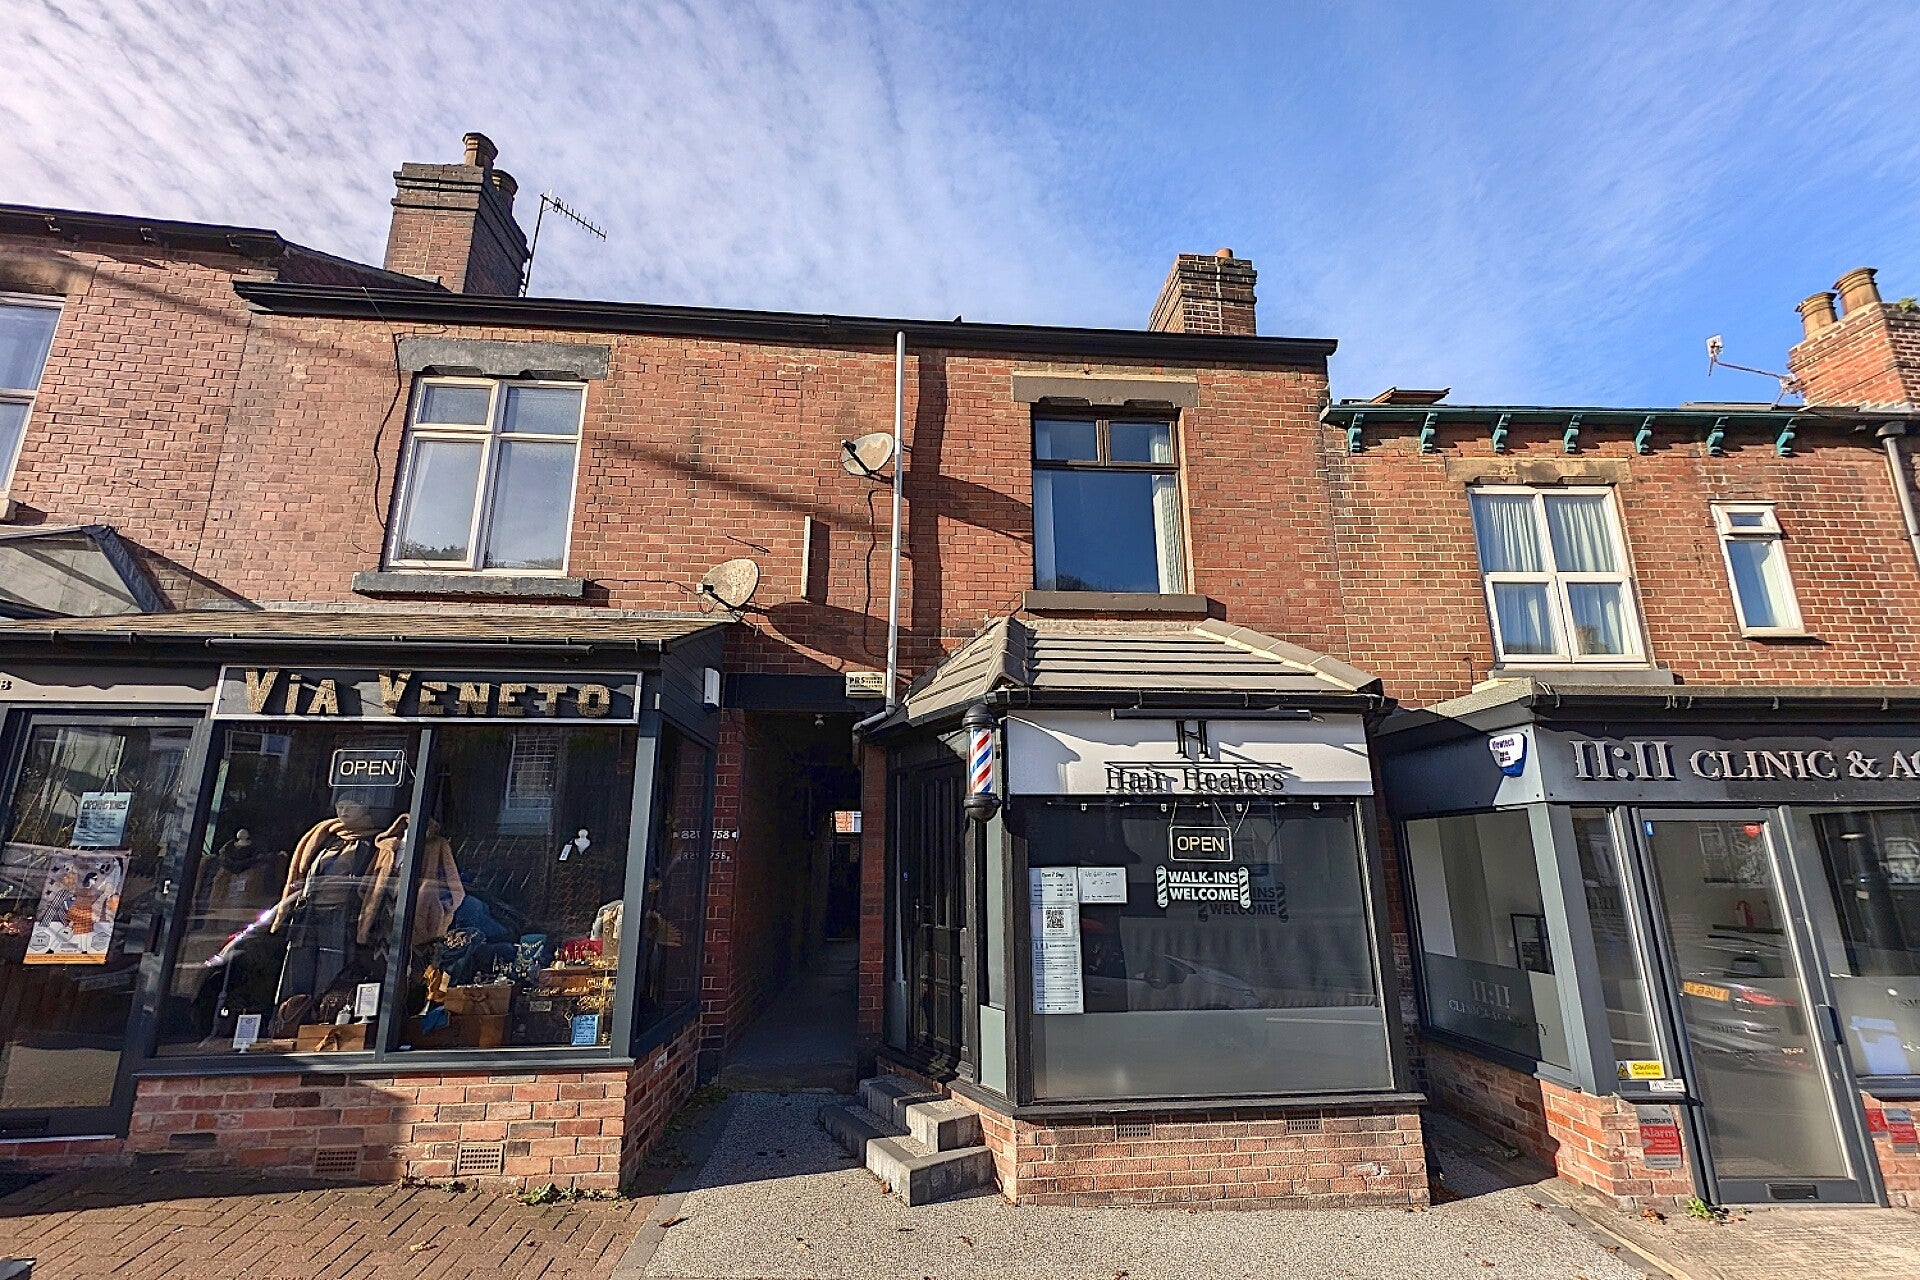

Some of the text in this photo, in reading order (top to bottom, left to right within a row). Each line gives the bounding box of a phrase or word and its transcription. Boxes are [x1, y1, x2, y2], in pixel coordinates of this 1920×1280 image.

[378, 669, 611, 717] VENETO
[339, 760, 397, 776] OPEN
[1689, 749, 1837, 779] CLINIC
[1845, 750, 1882, 779] &
[1104, 766, 1286, 791] Hair Healers
[711, 829, 731, 839] 758
[1176, 835, 1226, 852] OPEN
[1167, 870, 1239, 884] WALK-INS
[1169, 886, 1239, 900] WELCOME
[1642, 1127, 1675, 1138] Alarm
